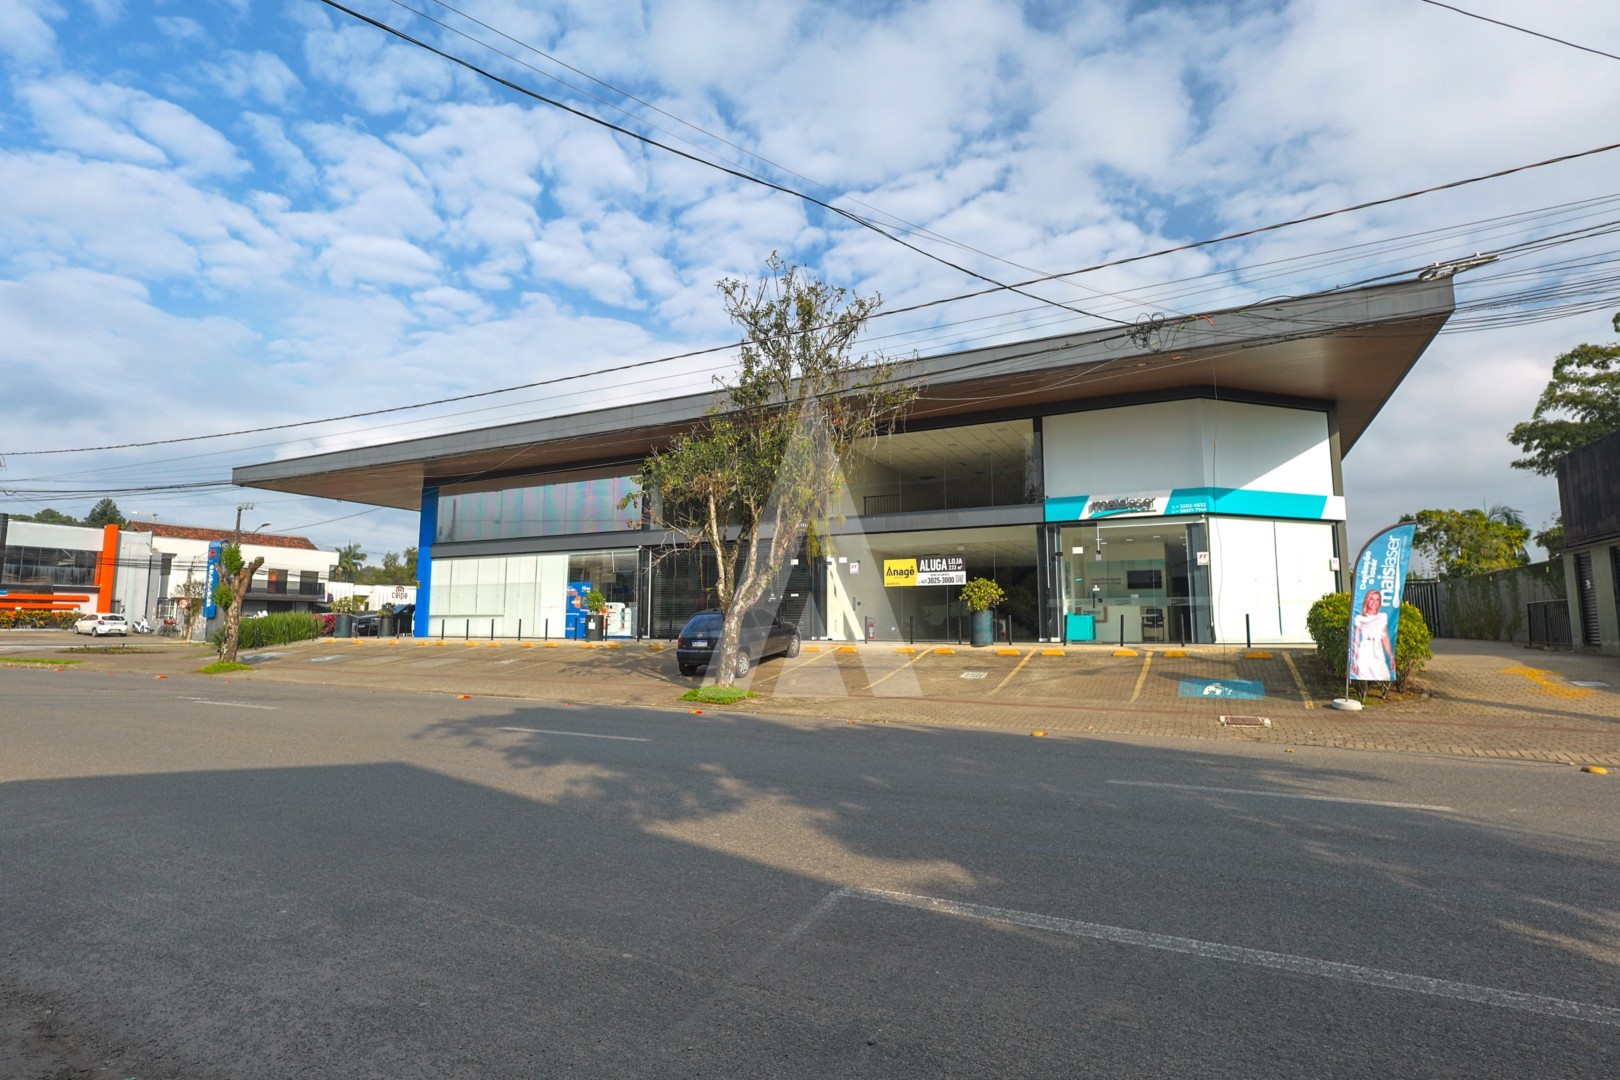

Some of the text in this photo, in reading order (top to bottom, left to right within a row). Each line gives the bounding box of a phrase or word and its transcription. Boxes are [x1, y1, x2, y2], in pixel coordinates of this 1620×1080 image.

[886, 565, 915, 579] Anagê
[919, 559, 948, 571] ALUGA
[1359, 551, 1372, 590] Depilação
[1368, 559, 1377, 578] laser
[1377, 535, 1400, 607] maislaser
[928, 576, 955, 584] 3025-3000
